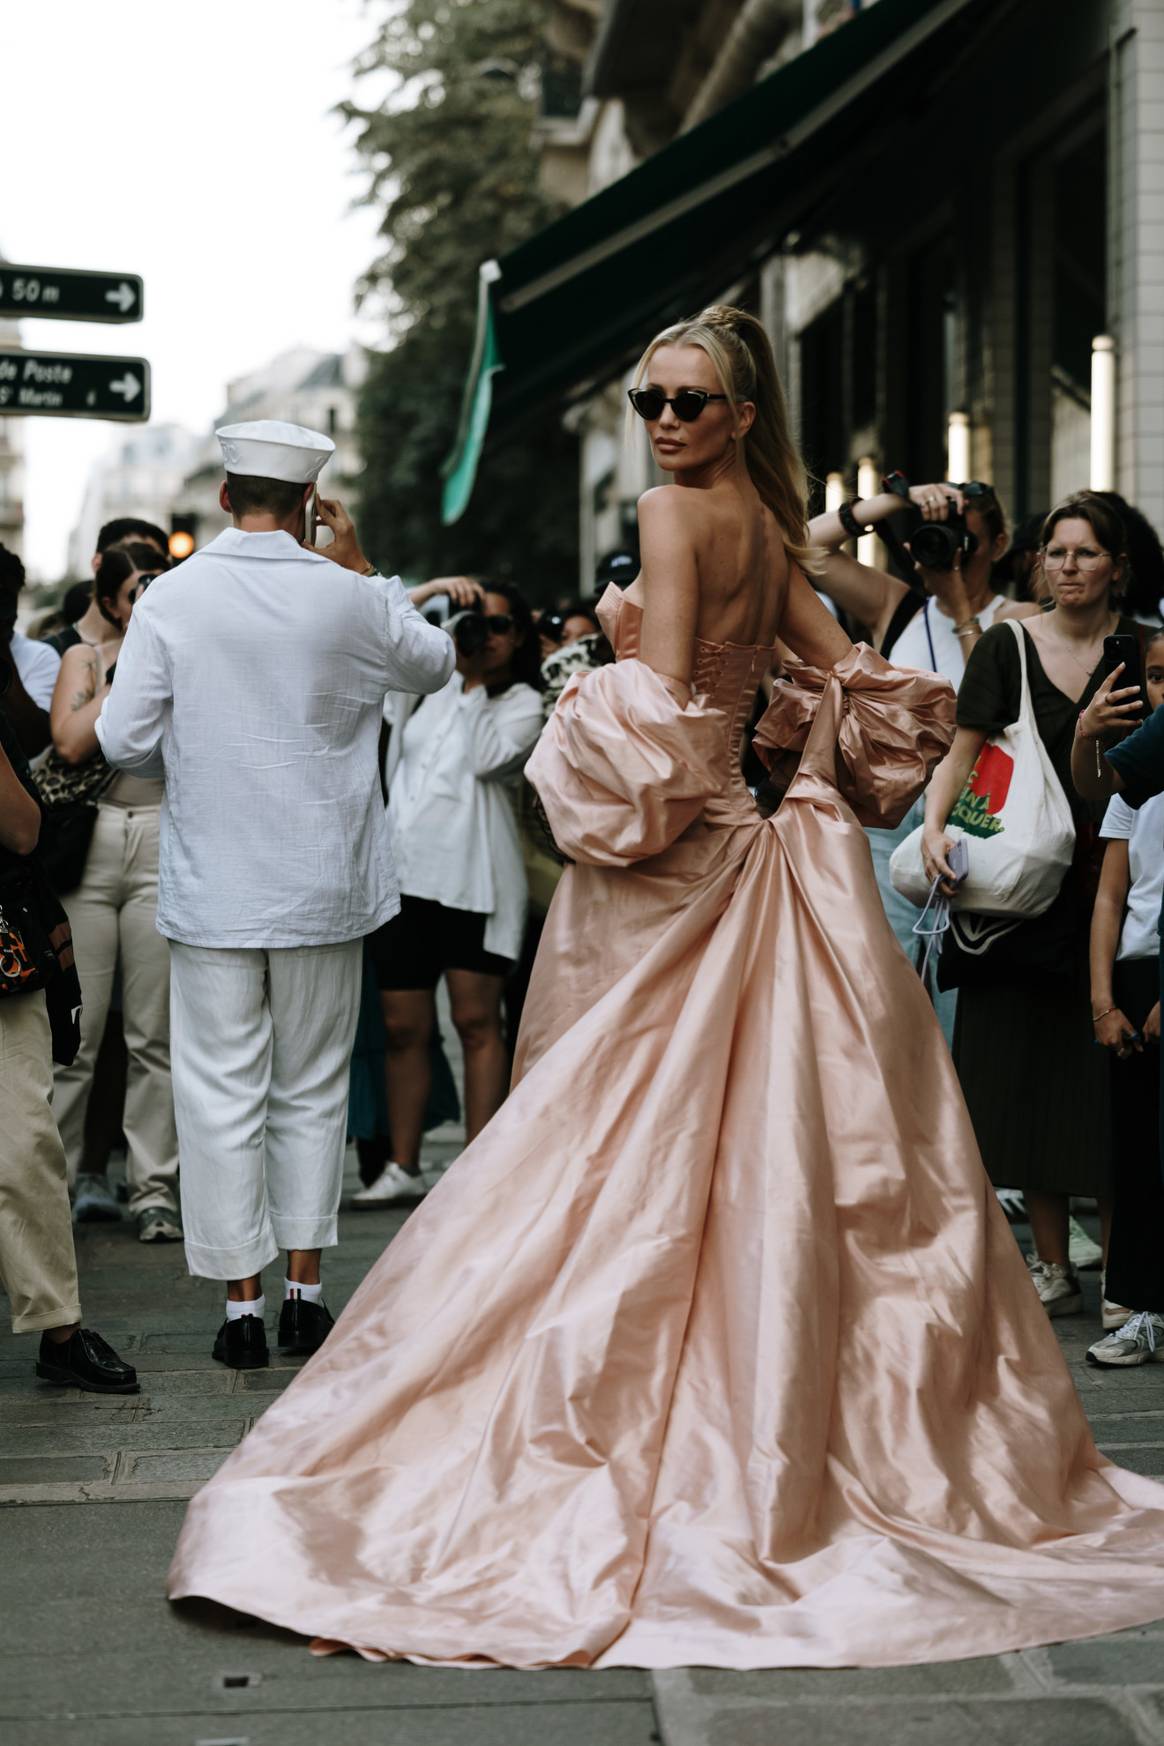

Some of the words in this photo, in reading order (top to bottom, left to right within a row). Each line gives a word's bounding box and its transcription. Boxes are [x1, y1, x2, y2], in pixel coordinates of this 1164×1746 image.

[12, 279, 40, 302] 50
[42, 286, 60, 303] m
[23, 359, 73, 384] Poste
[19, 387, 63, 406] Martin
